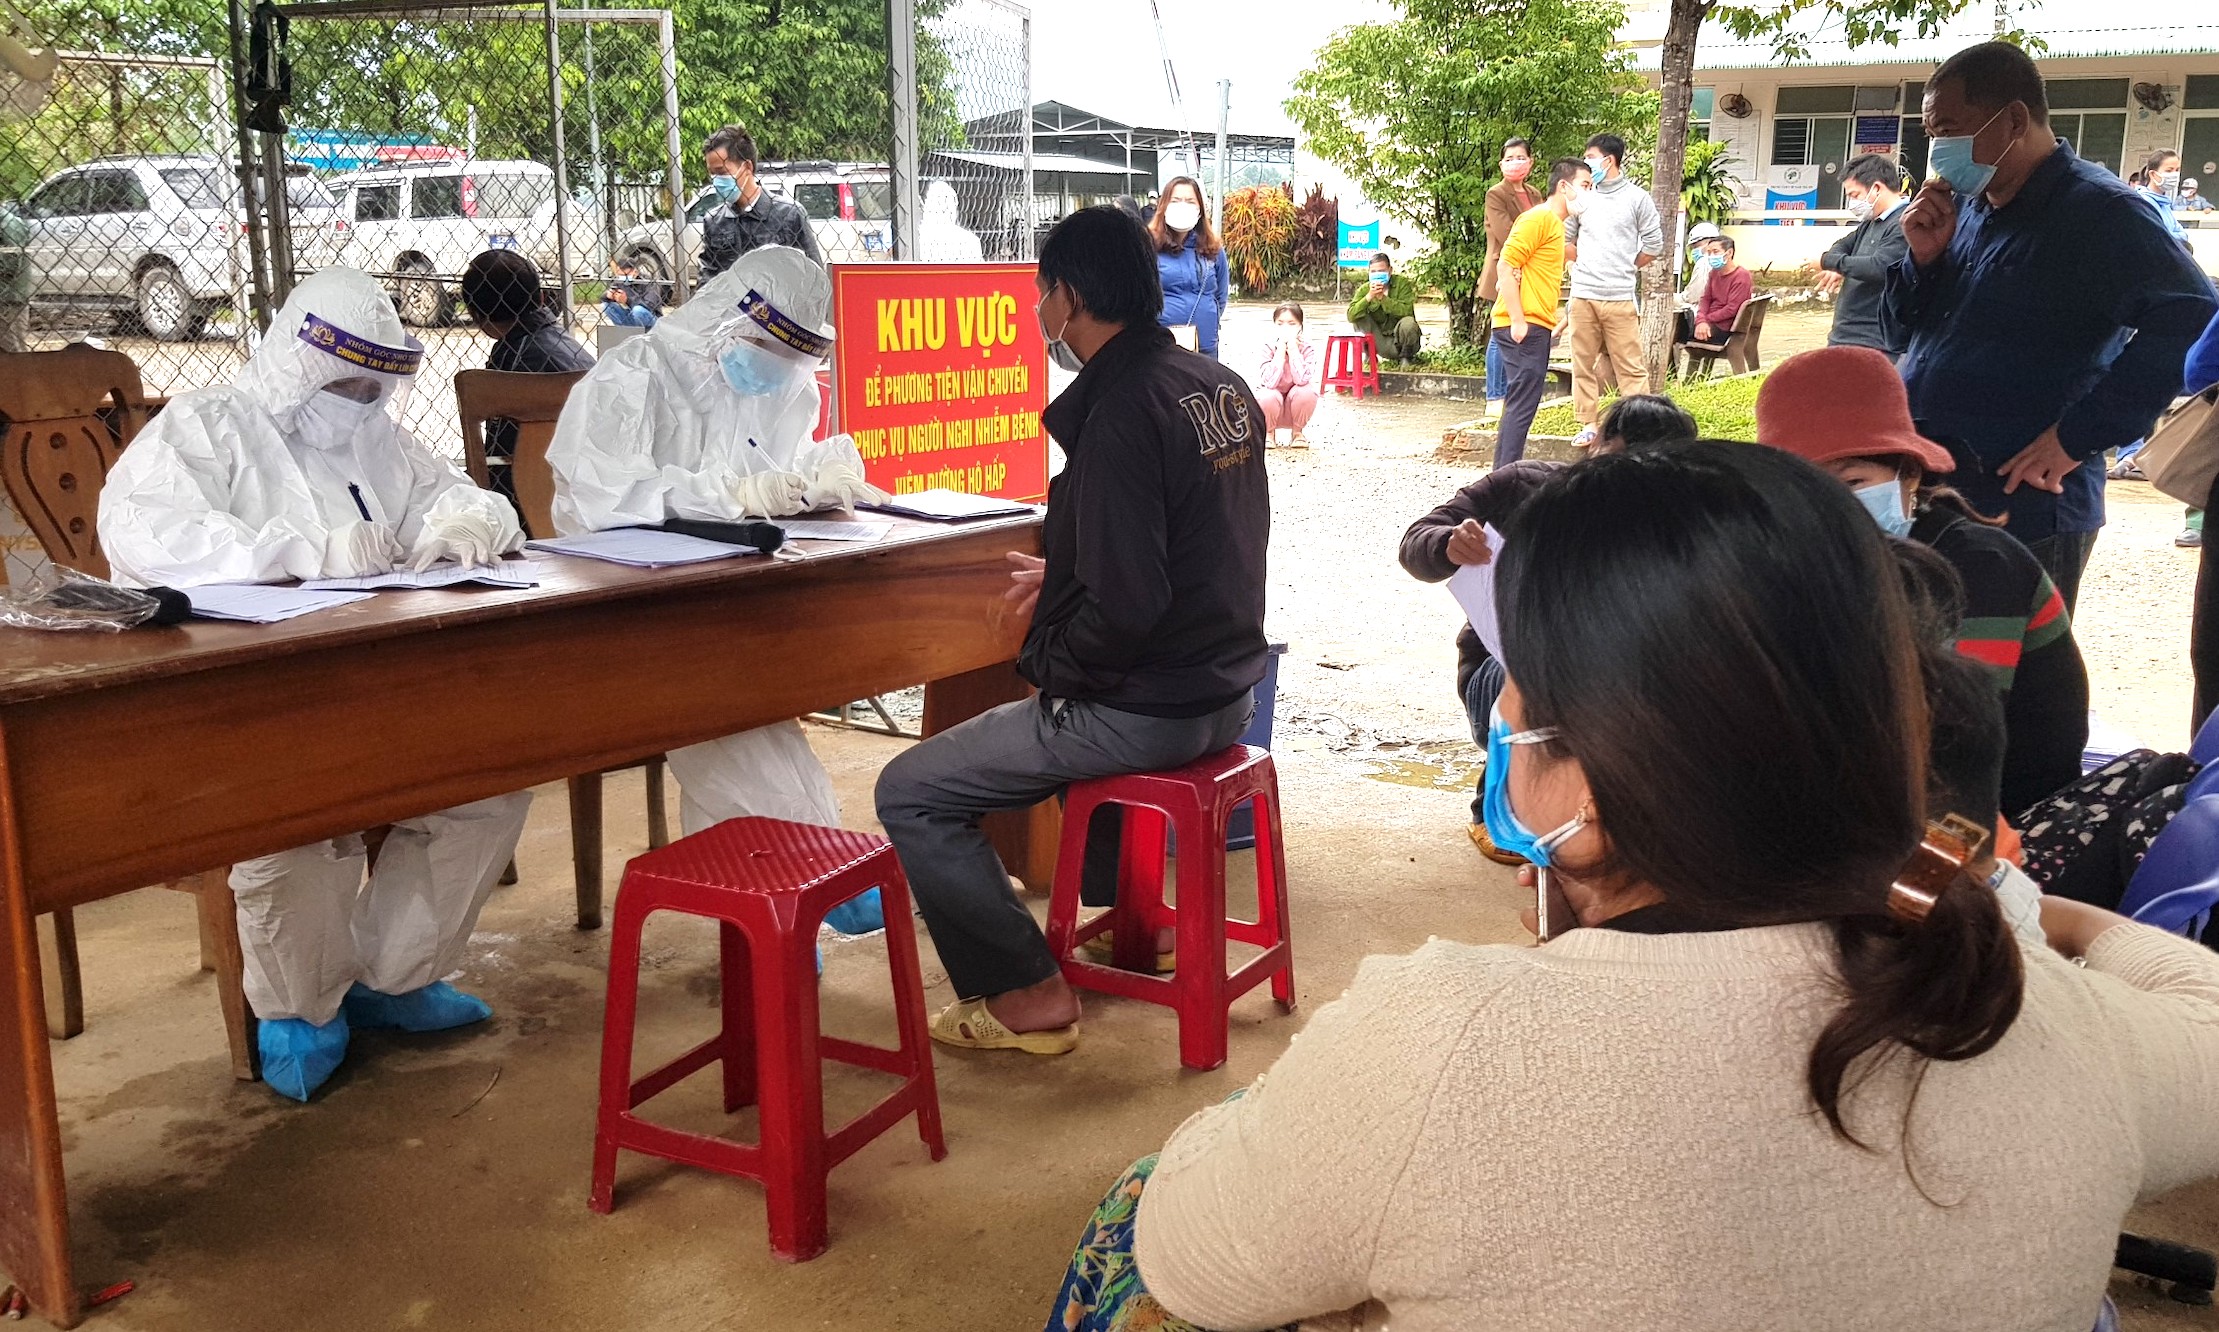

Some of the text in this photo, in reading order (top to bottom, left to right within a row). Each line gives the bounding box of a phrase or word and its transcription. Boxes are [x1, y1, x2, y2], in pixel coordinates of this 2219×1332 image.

[344, 337, 373, 355] NHÓM
[767, 322, 791, 341] CHUNG
[877, 291, 1017, 358] KHU VỰC
[335, 345, 366, 364] CHUNG
[367, 357, 383, 369] TAY
[865, 355, 1029, 408] ĐỂ PHƯƠNG TIỆN VẬN CHUYỂN
[854, 406, 1039, 465] PHỤC VỤ NGƯỜI NGHI NHIỄM BỆNH
[1179, 384, 1250, 454] RG
[895, 469, 924, 496] VIÊM
[968, 460, 982, 494] HÔ
[985, 454, 1007, 492] HẤP
